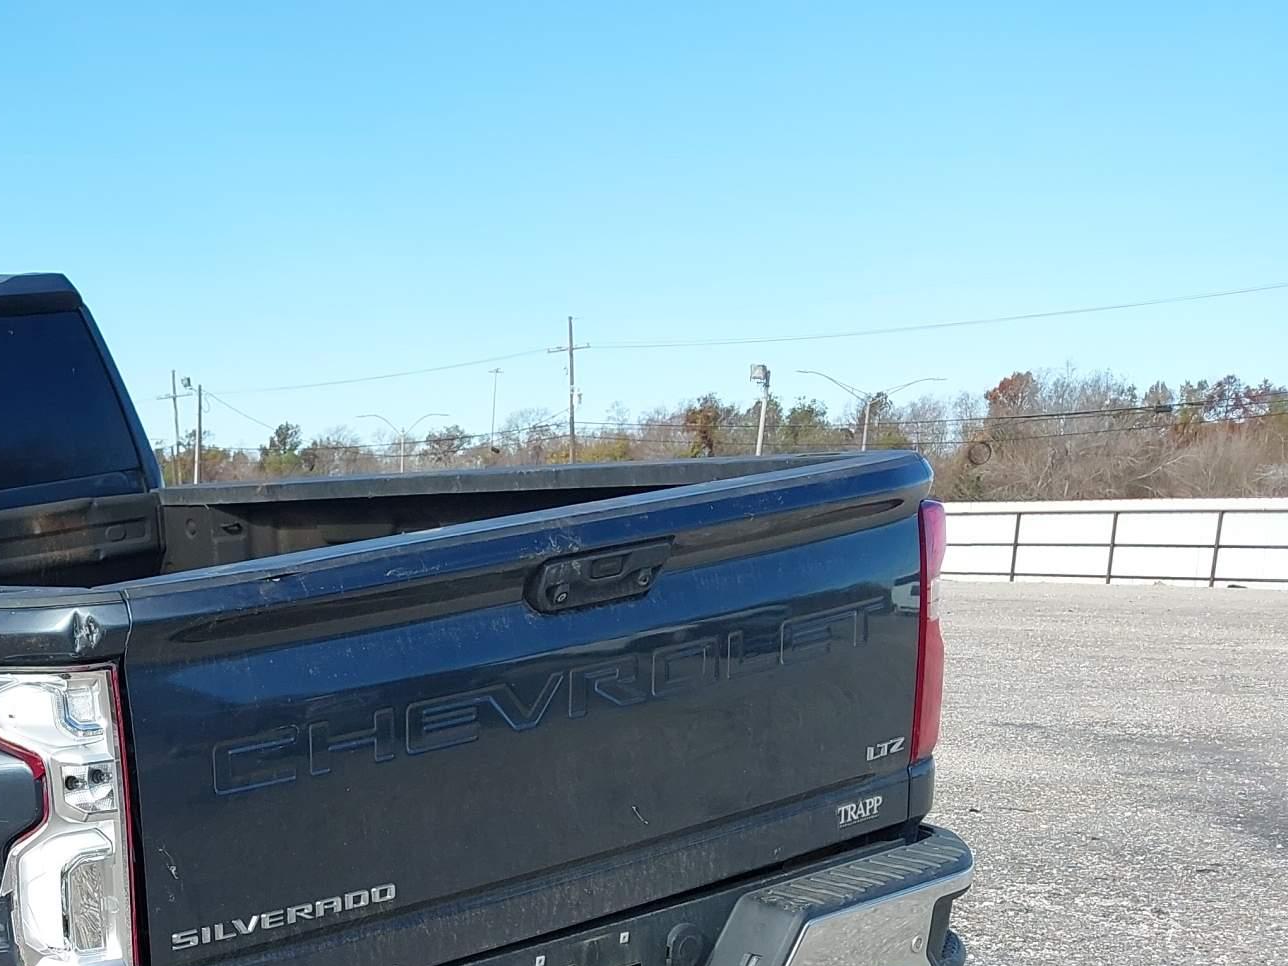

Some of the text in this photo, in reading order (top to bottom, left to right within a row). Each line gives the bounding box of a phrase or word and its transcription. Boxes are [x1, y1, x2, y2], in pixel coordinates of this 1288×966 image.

[212, 596, 885, 796] CHEVROLET
[866, 736, 905, 761] LTZ
[837, 796, 883, 825] TRAPP
[171, 882, 396, 951] SILVERADO
